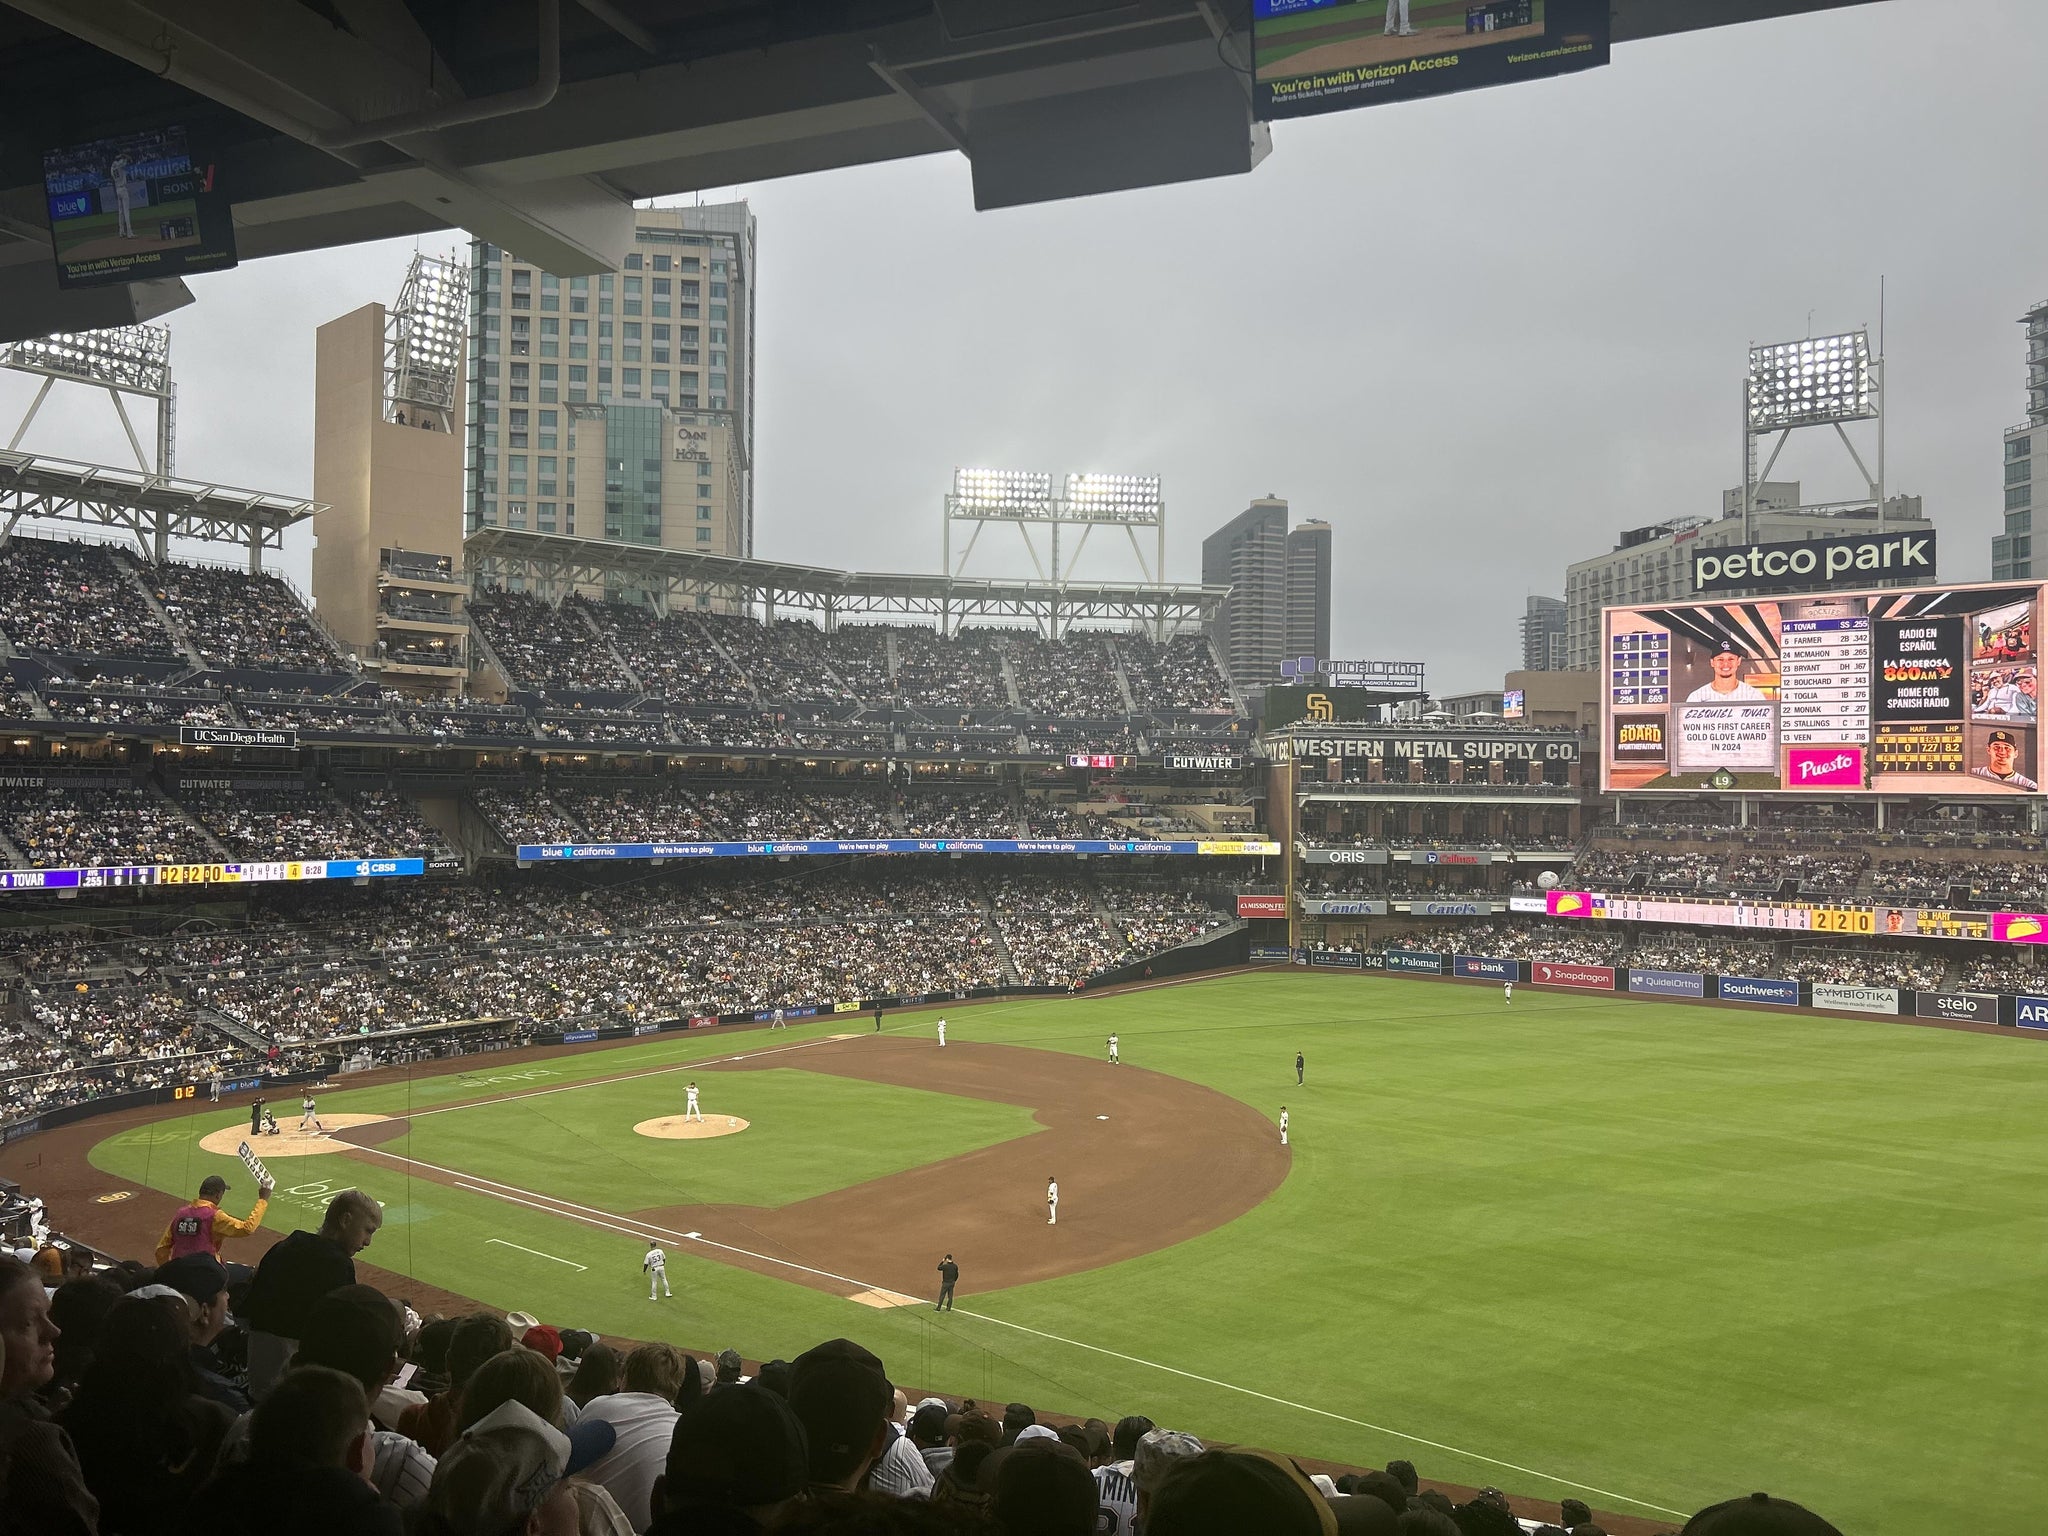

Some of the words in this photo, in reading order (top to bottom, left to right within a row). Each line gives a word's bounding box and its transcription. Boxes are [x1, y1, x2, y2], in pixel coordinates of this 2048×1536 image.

[1507, 43, 1593, 64] Verizon.com/access
[1272, 79, 1311, 95] You're
[1313, 77, 1325, 88] in
[1327, 70, 1355, 87] with
[1357, 64, 1406, 82] Verizon
[1409, 55, 1459, 72] Access
[1360, 80, 1375, 90] and
[57, 200, 77, 213] blue
[66, 262, 87, 274] You're
[94, 257, 110, 271] with
[109, 255, 135, 268] Verizon
[135, 252, 161, 265] Access
[678, 428, 707, 440] OMNI
[675, 448, 710, 461] HOTEL
[1696, 546, 1818, 590] petco
[1826, 536, 1930, 581] park
[1783, 624, 1791, 632] 14
[1793, 622, 1817, 631] TOVAR
[1840, 621, 1850, 629] SS
[1899, 628, 1925, 639] RADIO
[1925, 627, 1937, 638] EN
[1622, 642, 1631, 650] 51
[1650, 640, 1659, 649] 13
[1793, 636, 1822, 645] FARMER
[1840, 635, 1850, 643] 2B
[1899, 639, 1937, 652] ESPAÑOL
[1782, 651, 1791, 659] 24
[1793, 650, 1830, 659] MCMAHON
[1318, 659, 1419, 677] QuidelOrtho
[1623, 659, 1629, 668] 4
[1651, 659, 1658, 667] 0
[1793, 664, 1820, 672] BRYANT
[1839, 663, 1850, 671] DH
[1883, 659, 1898, 669] LA
[1394, 680, 1415, 688] PARTNER
[1623, 677, 1629, 686] 4
[1651, 676, 1658, 685] 4
[1793, 677, 1832, 686] BOUCHARD
[1840, 677, 1849, 685] RF
[1793, 692, 1818, 700] TOGLIA
[1897, 687, 1922, 697] HOME
[1922, 686, 1939, 697] FOR
[1887, 698, 1923, 709] SPANISH
[1923, 697, 1950, 708] RADIO
[1684, 708, 1734, 719] EZEQUIEL
[1741, 707, 1770, 718] TOVAR
[1840, 705, 1850, 713] CF
[1683, 723, 1701, 731] WON
[1702, 723, 1716, 731] HIS
[1717, 722, 1739, 731] FIRST
[1740, 722, 1771, 730] CAREER
[1793, 719, 1831, 728] STALLINGS
[194, 730, 212, 742] UC
[211, 730, 229, 742] San
[230, 731, 257, 745] Diego
[257, 733, 286, 744] Health
[1619, 727, 1662, 744] BOARD
[1686, 733, 1708, 741] GOLD
[1709, 733, 1736, 741] GLOVE
[1736, 732, 1767, 741] AWARD
[1793, 733, 1812, 741] VEEN
[1840, 733, 1849, 741] LF
[1292, 739, 1385, 758] WESTERN
[1394, 740, 1459, 759] METAL
[1463, 741, 1538, 760] SUPPLY
[1545, 743, 1578, 760] CO.
[1711, 743, 1720, 751] IN
[1721, 743, 1742, 751] 2024
[1904, 743, 1911, 753] 0
[1921, 743, 1938, 752] 7.27
[1944, 743, 1960, 752] 8.2
[1172, 757, 1233, 769] CUTWATER
[1797, 753, 1853, 780] Puesto
[1883, 762, 1889, 771] 7
[1904, 762, 1911, 771] 7
[1926, 762, 1934, 771] 5
[1949, 762, 1956, 771] 6
[180, 779, 231, 789] CUTWATER
[1715, 776, 1729, 786] L9
[652, 846, 673, 854] We're
[673, 846, 689, 854] here
[689, 846, 698, 854] to
[698, 845, 715, 855] play
[747, 844, 765, 853] blue
[772, 843, 808, 852] california
[838, 842, 856, 851] We're
[855, 842, 869, 850] here
[876, 842, 889, 851] play
[919, 841, 937, 850] blue
[945, 841, 984, 850] california
[1017, 841, 1036, 850] We're
[1036, 841, 1052, 850] here
[1053, 841, 1060, 850] to
[1060, 841, 1076, 852] play
[1108, 842, 1126, 851] blue
[1134, 842, 1172, 852] california
[542, 847, 563, 857] blue
[573, 846, 616, 857] california
[1329, 851, 1365, 863] ORIS
[1439, 852, 1479, 864] Calimax
[305, 865, 322, 875] 6:28
[371, 863, 397, 873] CBS8
[170, 867, 179, 882] 2
[191, 866, 200, 881] 2
[212, 866, 221, 881] 0
[12, 873, 45, 887] TOVAR
[82, 876, 103, 887] .255
[1248, 902, 1275, 910] MISSION
[1320, 901, 1373, 914] Canel's
[1426, 901, 1477, 915] Canel's
[1932, 911, 1951, 921] HART
[1817, 913, 1827, 929] 2
[1838, 914, 1848, 930] 2
[1859, 915, 1869, 931] 0
[1365, 956, 1383, 967] 342
[1401, 956, 1440, 969] Palomar
[1480, 961, 1505, 974] bank
[1555, 970, 1609, 984] Snapdragon
[1645, 977, 1700, 990] QuidelOrtho
[1723, 983, 1785, 998] Southwest
[1815, 987, 1895, 1003] CYMBIOTIKA
[1937, 996, 1978, 1012] stelo
